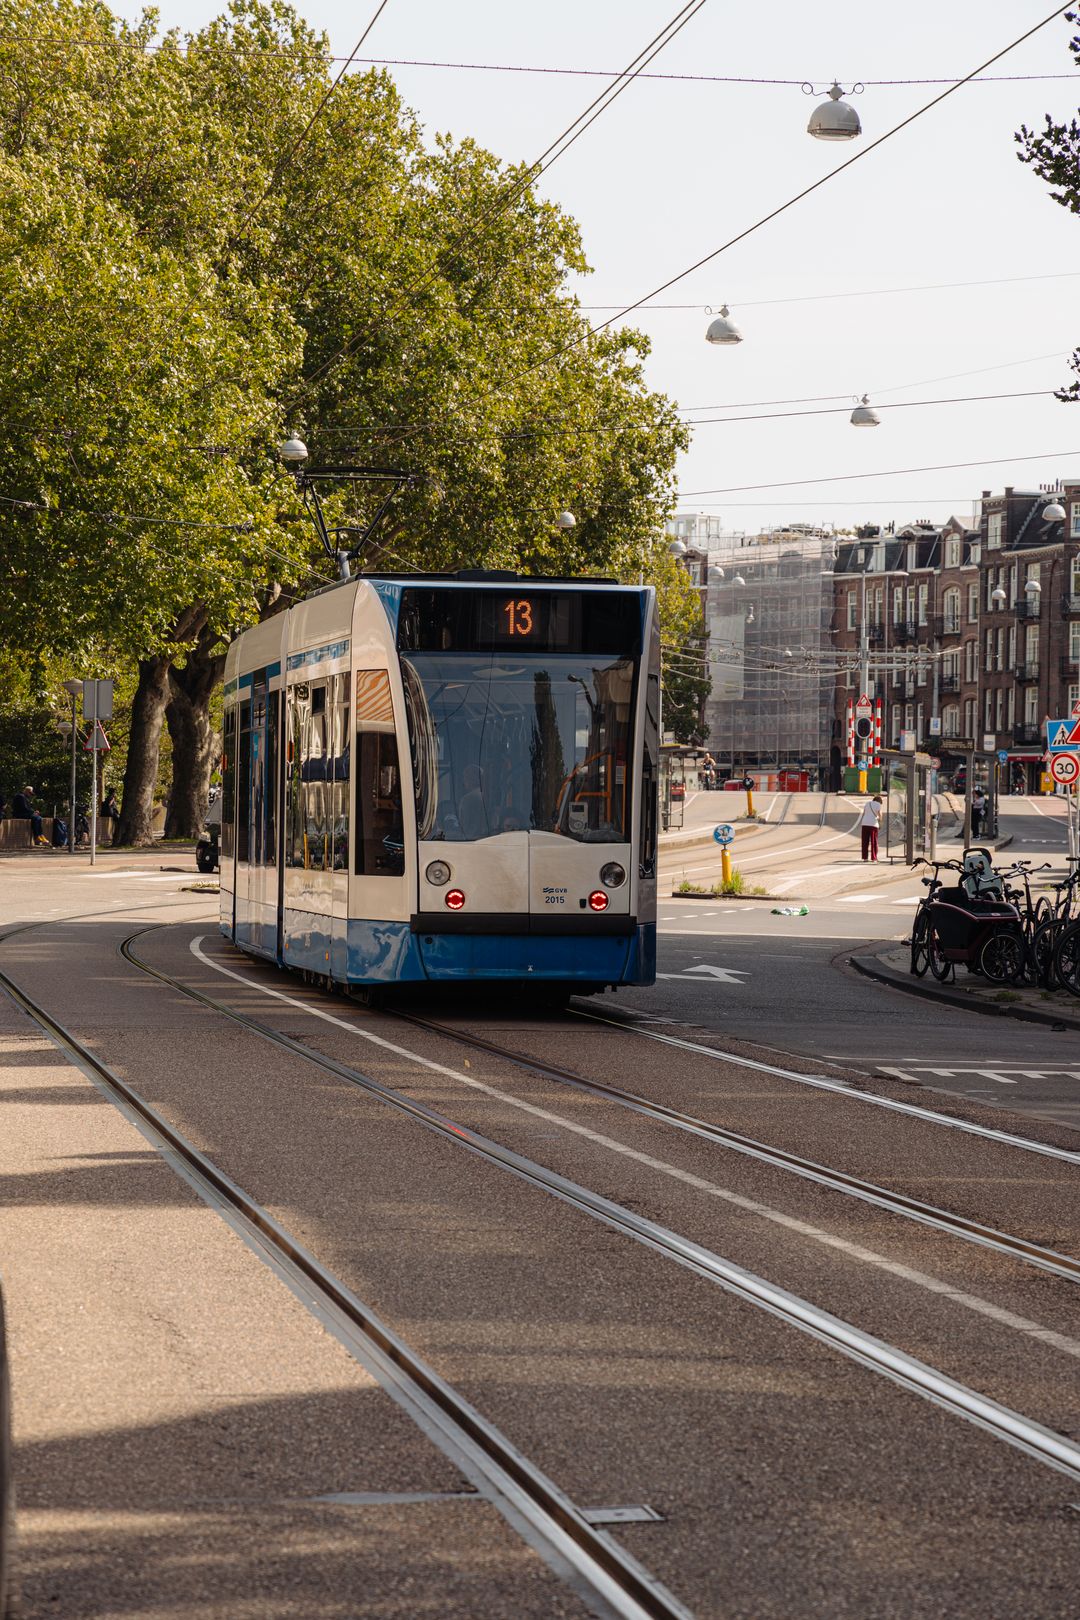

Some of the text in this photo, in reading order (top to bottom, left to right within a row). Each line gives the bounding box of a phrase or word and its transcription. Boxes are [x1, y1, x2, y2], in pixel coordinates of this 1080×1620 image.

[504, 600, 532, 635] 13
[1056, 762, 1075, 775] 30
[545, 896, 565, 904] 2015
